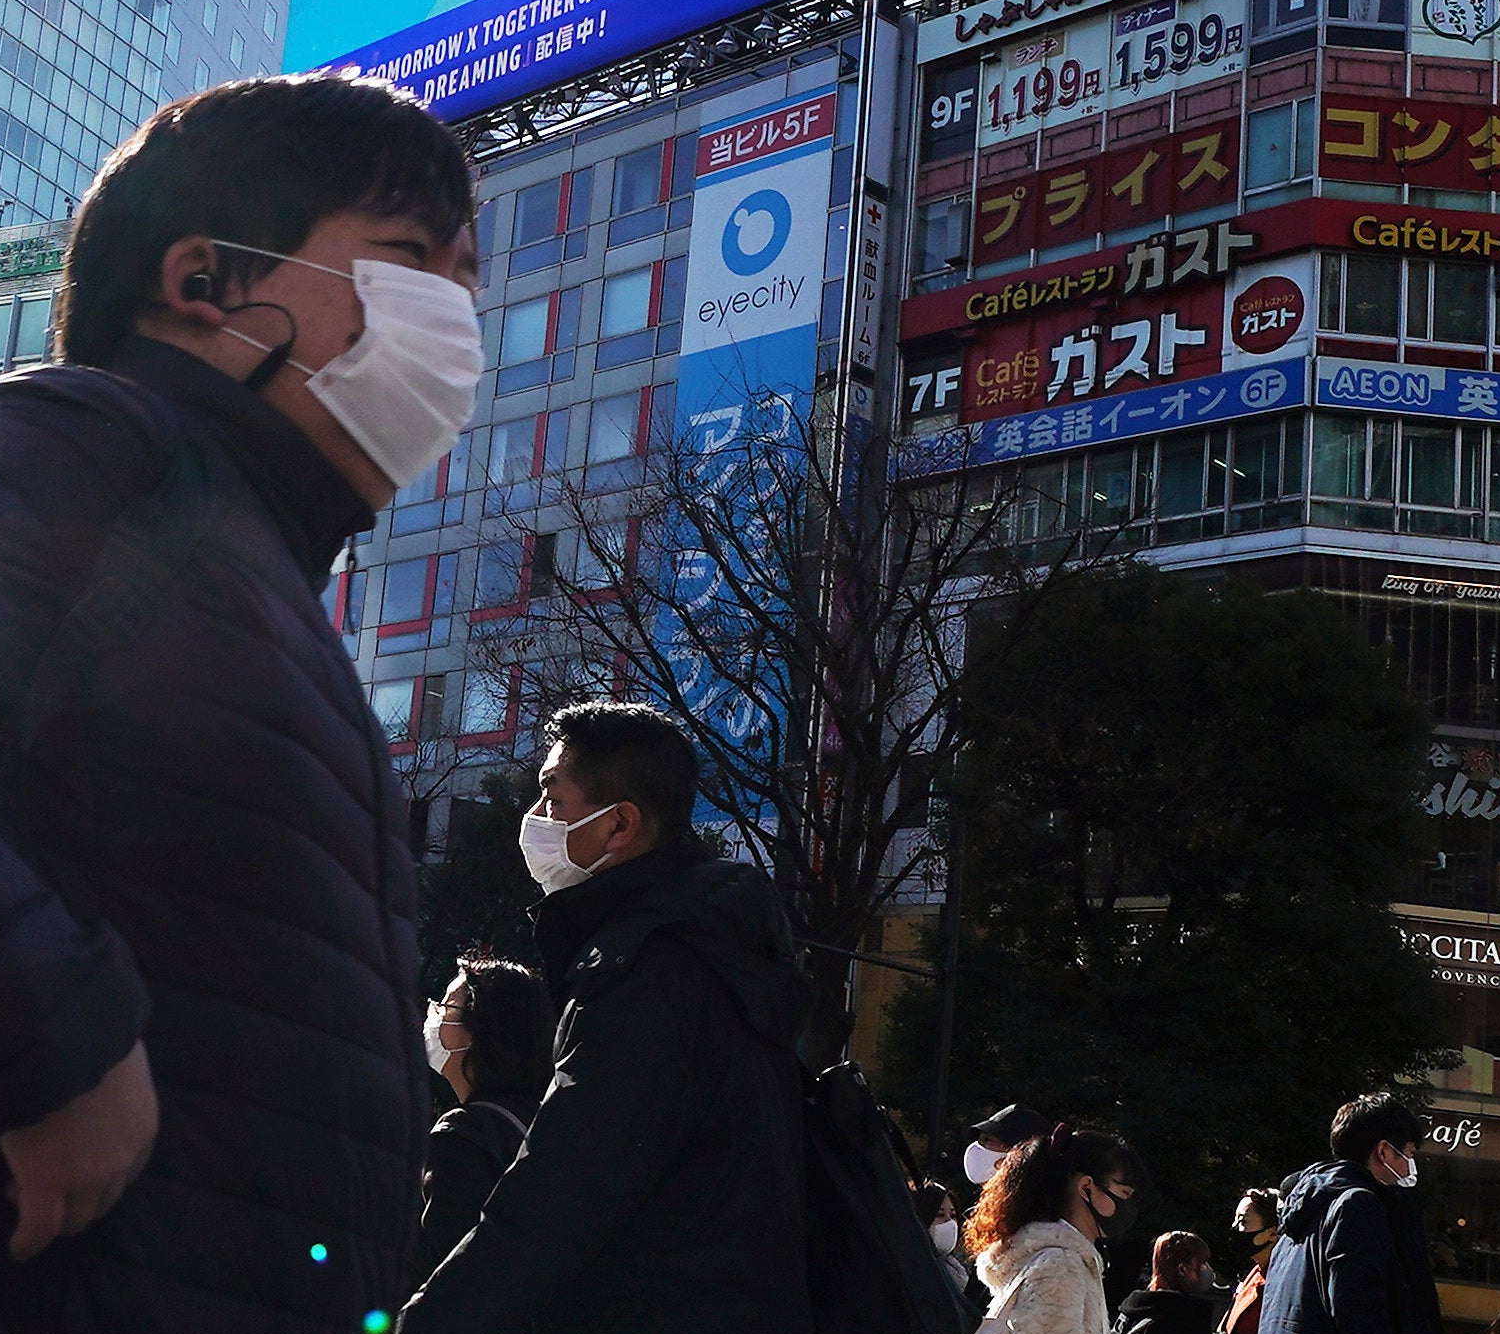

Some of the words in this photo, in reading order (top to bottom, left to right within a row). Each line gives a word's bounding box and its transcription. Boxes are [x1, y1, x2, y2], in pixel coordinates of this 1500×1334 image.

[1120, 2, 1172, 32] ディナー
[930, 88, 974, 130] 9F
[708, 104, 820, 167] 当ビル5F
[980, 131, 1231, 247] プライス
[13, 250, 62, 273] CIT
[1124, 223, 1255, 295] ガスト
[698, 276, 806, 327] eyecity
[1240, 307, 1297, 336] ガスト
[975, 349, 1040, 388] Café
[1046, 313, 1206, 402] ガスト
[908, 366, 962, 414] 7F
[1244, 371, 1283, 403] 6F
[1335, 368, 1431, 403] AEON
